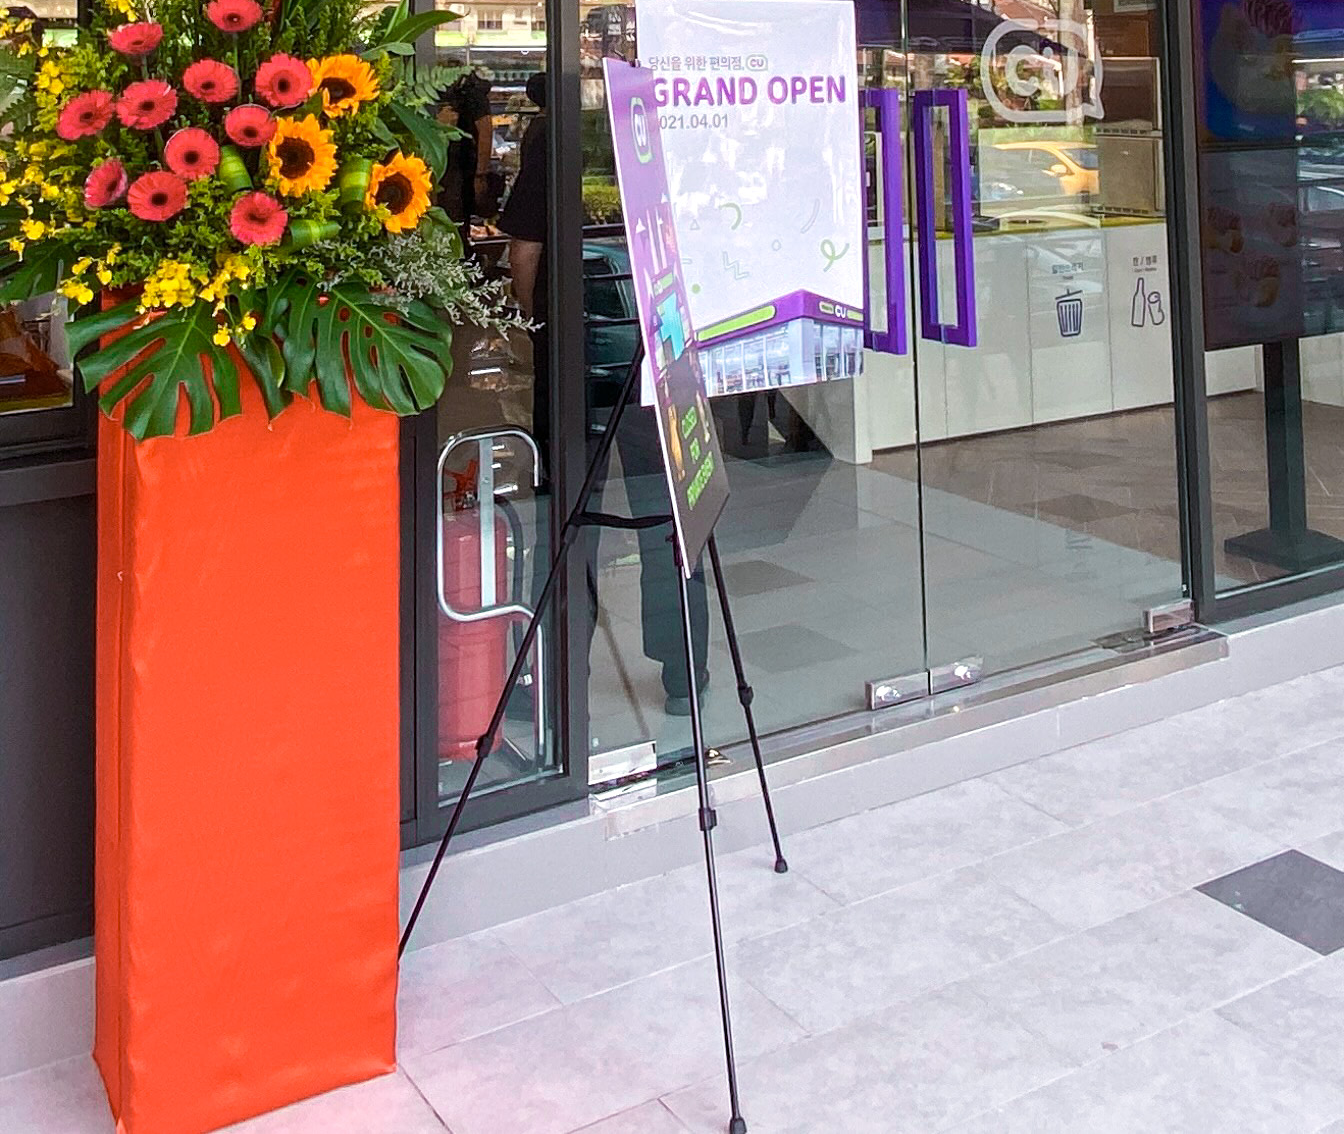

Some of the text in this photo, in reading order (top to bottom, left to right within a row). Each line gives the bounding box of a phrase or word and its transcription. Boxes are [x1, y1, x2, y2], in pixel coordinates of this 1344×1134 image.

[684, 55, 708, 71] 위한
[655, 75, 847, 108] GRAND OPEN
[659, 113, 729, 130] 021.04.01
